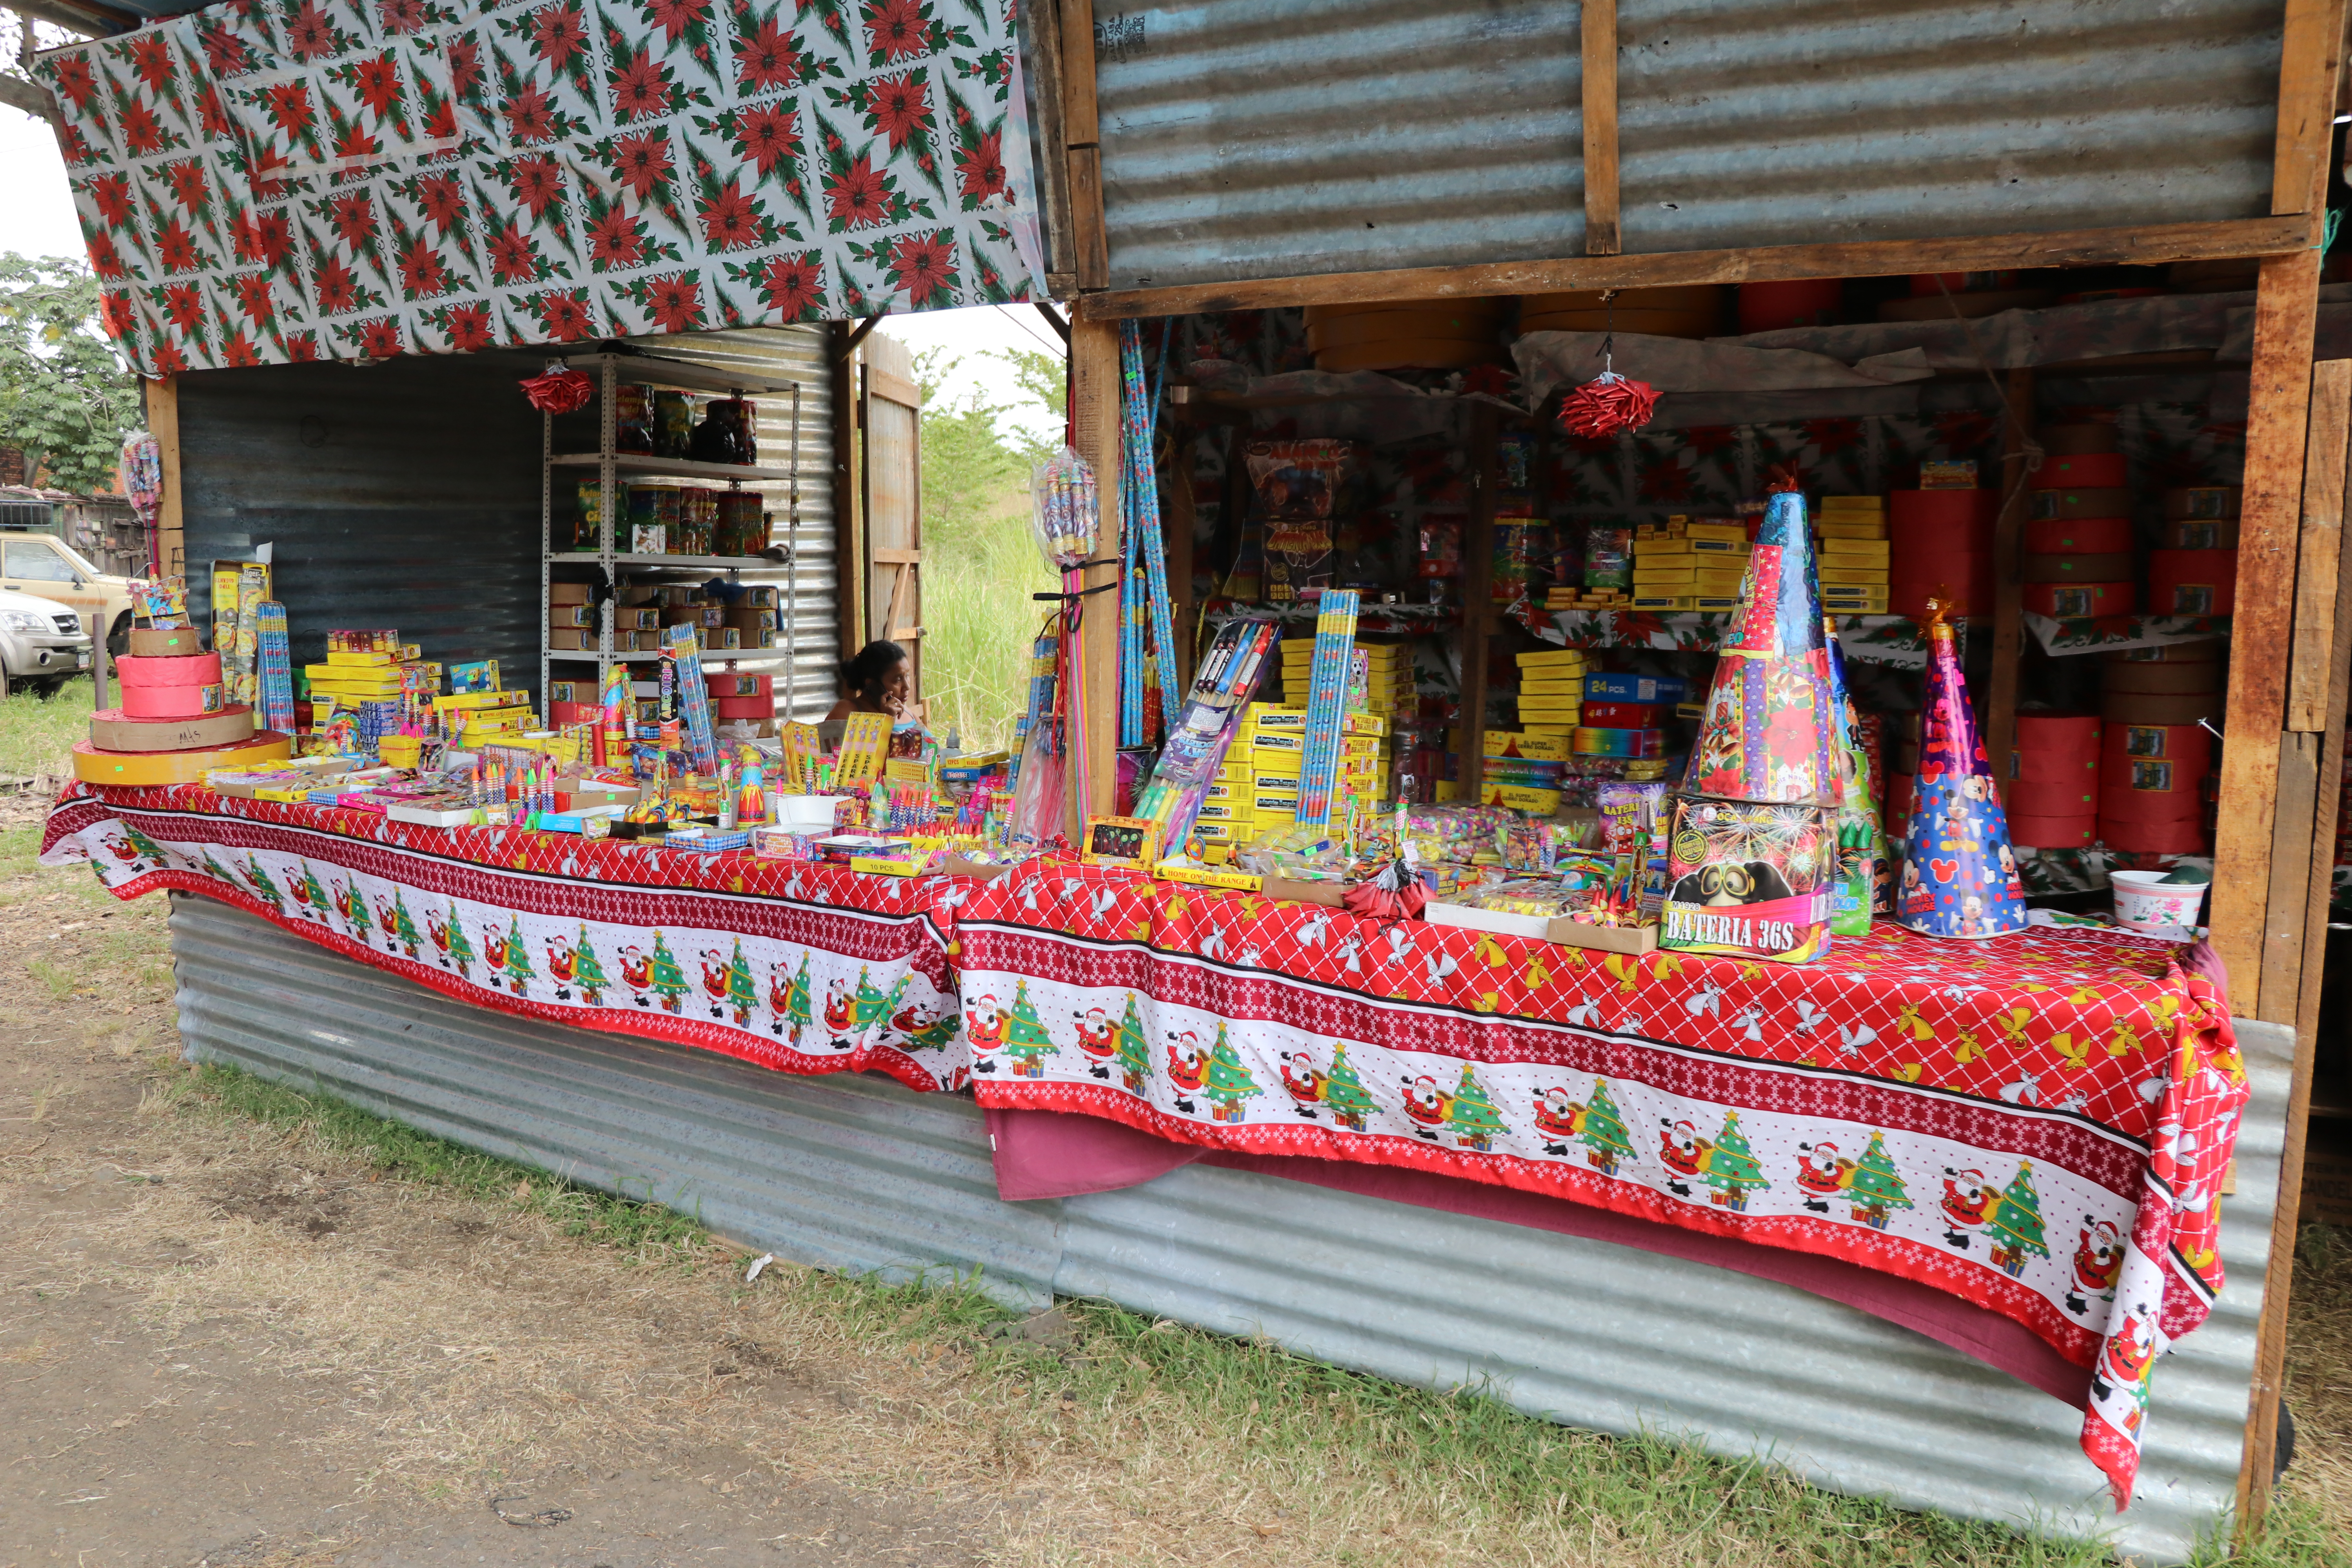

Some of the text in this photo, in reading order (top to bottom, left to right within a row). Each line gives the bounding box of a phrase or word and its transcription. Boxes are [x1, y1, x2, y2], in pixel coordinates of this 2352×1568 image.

[1744, 565, 1755, 609] GANTE
[661, 661, 673, 719] ARCOIRIS
[1592, 680, 1607, 693] 24
[1719, 693, 1741, 706] Navidad
[1179, 745, 1209, 758] SKY
[1483, 760, 1505, 771] GANTE
[1507, 762, 1529, 774] BLACK
[1771, 774, 1814, 792] Feliz Navidad
[1603, 802, 1639, 815] BATERI
[1617, 815, 1633, 824] 13S
[1717, 812, 1773, 824] OCA CHANG
[1168, 869, 1189, 878] HOME
[1221, 877, 1246, 886] RANGE
[1672, 901, 1700, 911] M1928
[1906, 893, 1936, 906] MICKEY
[1907, 901, 1936, 914] MOUSE
[1666, 911, 1752, 947] BATERIA
[1758, 919, 1794, 951] 36S
